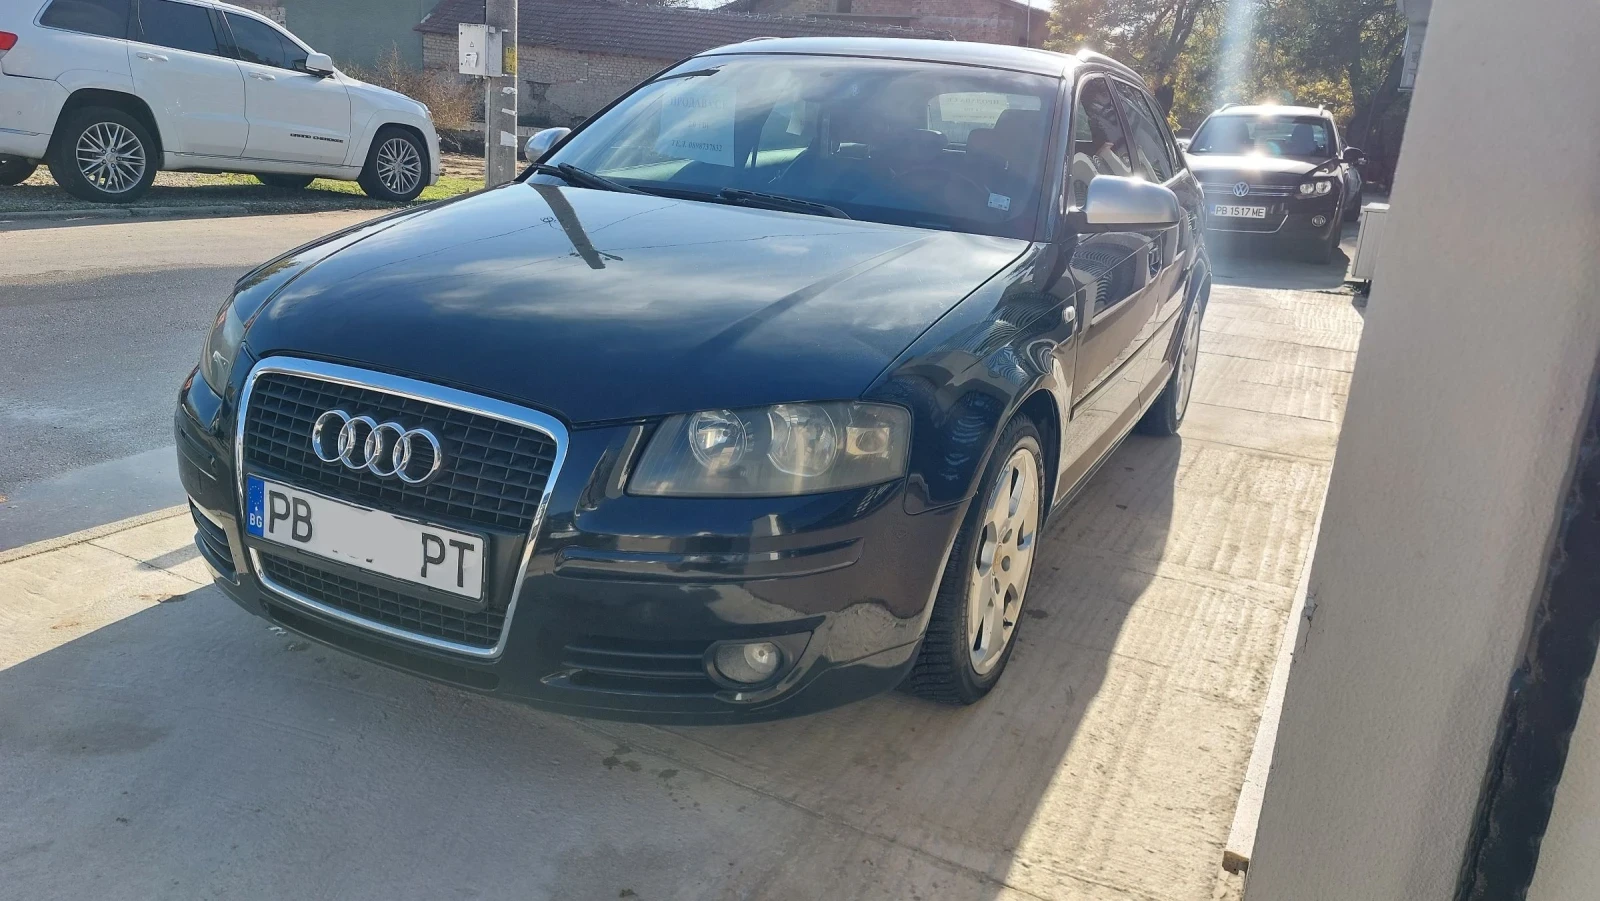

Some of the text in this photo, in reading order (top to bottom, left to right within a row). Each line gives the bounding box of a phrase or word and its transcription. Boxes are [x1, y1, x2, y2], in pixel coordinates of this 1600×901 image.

[1215, 206, 1265, 217] PB 1517 ME
[250, 512, 263, 528] BG
[268, 489, 475, 588] PB PT
